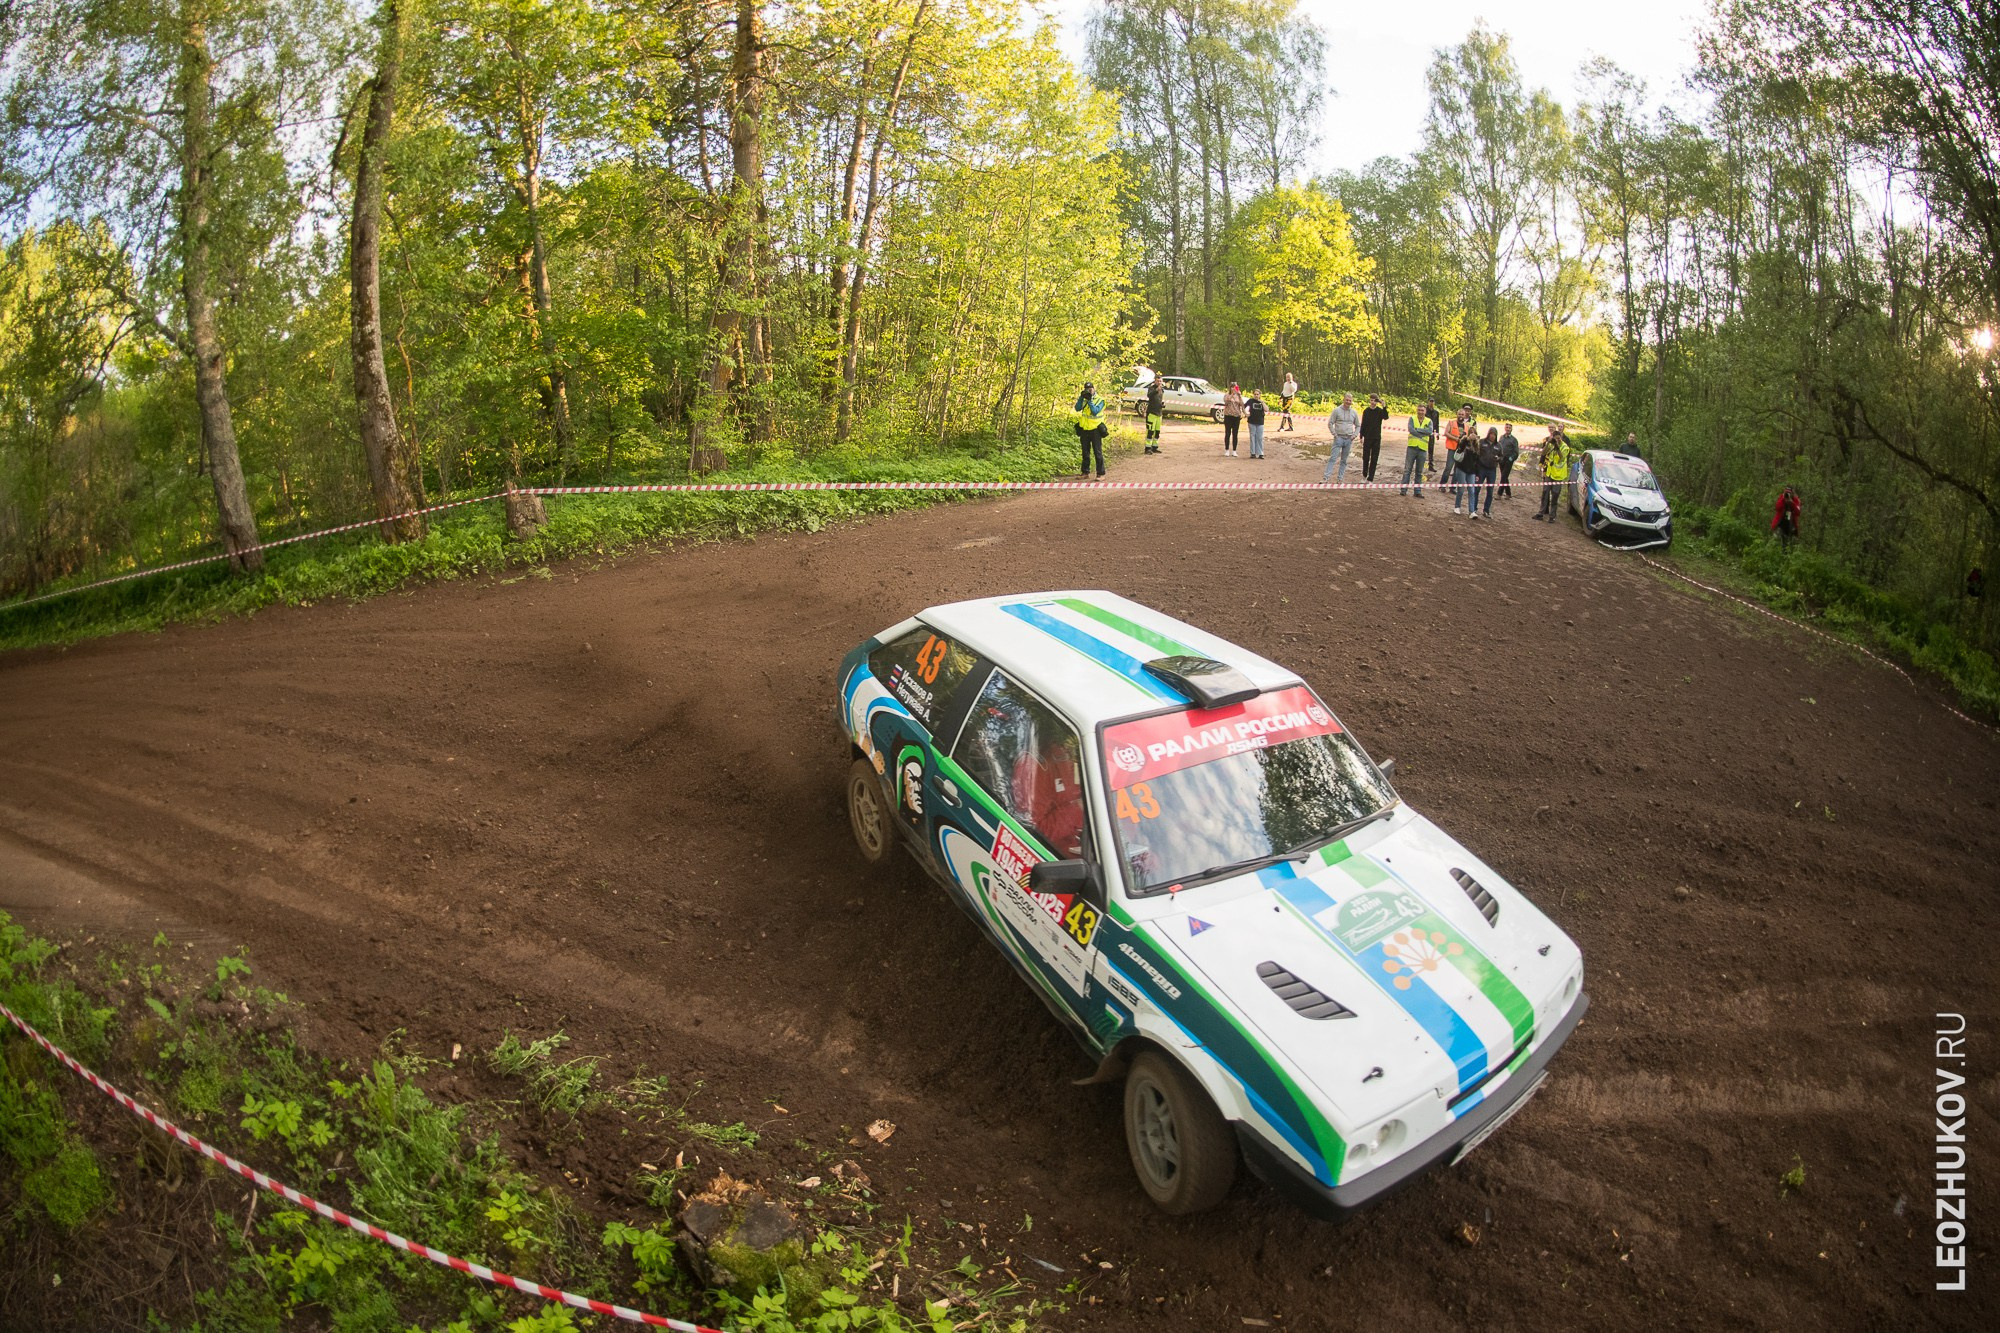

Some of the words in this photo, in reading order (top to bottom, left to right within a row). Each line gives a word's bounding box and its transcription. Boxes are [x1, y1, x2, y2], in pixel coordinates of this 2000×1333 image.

[916, 634, 947, 685] 43
[1147, 725, 1231, 762] РАЛЛИ
[1234, 711, 1312, 739] РОССИИ
[1116, 782, 1161, 824] 43
[996, 844, 1024, 881] 1945
[1065, 902, 1096, 945] 43
[1394, 895, 1424, 918] 43
